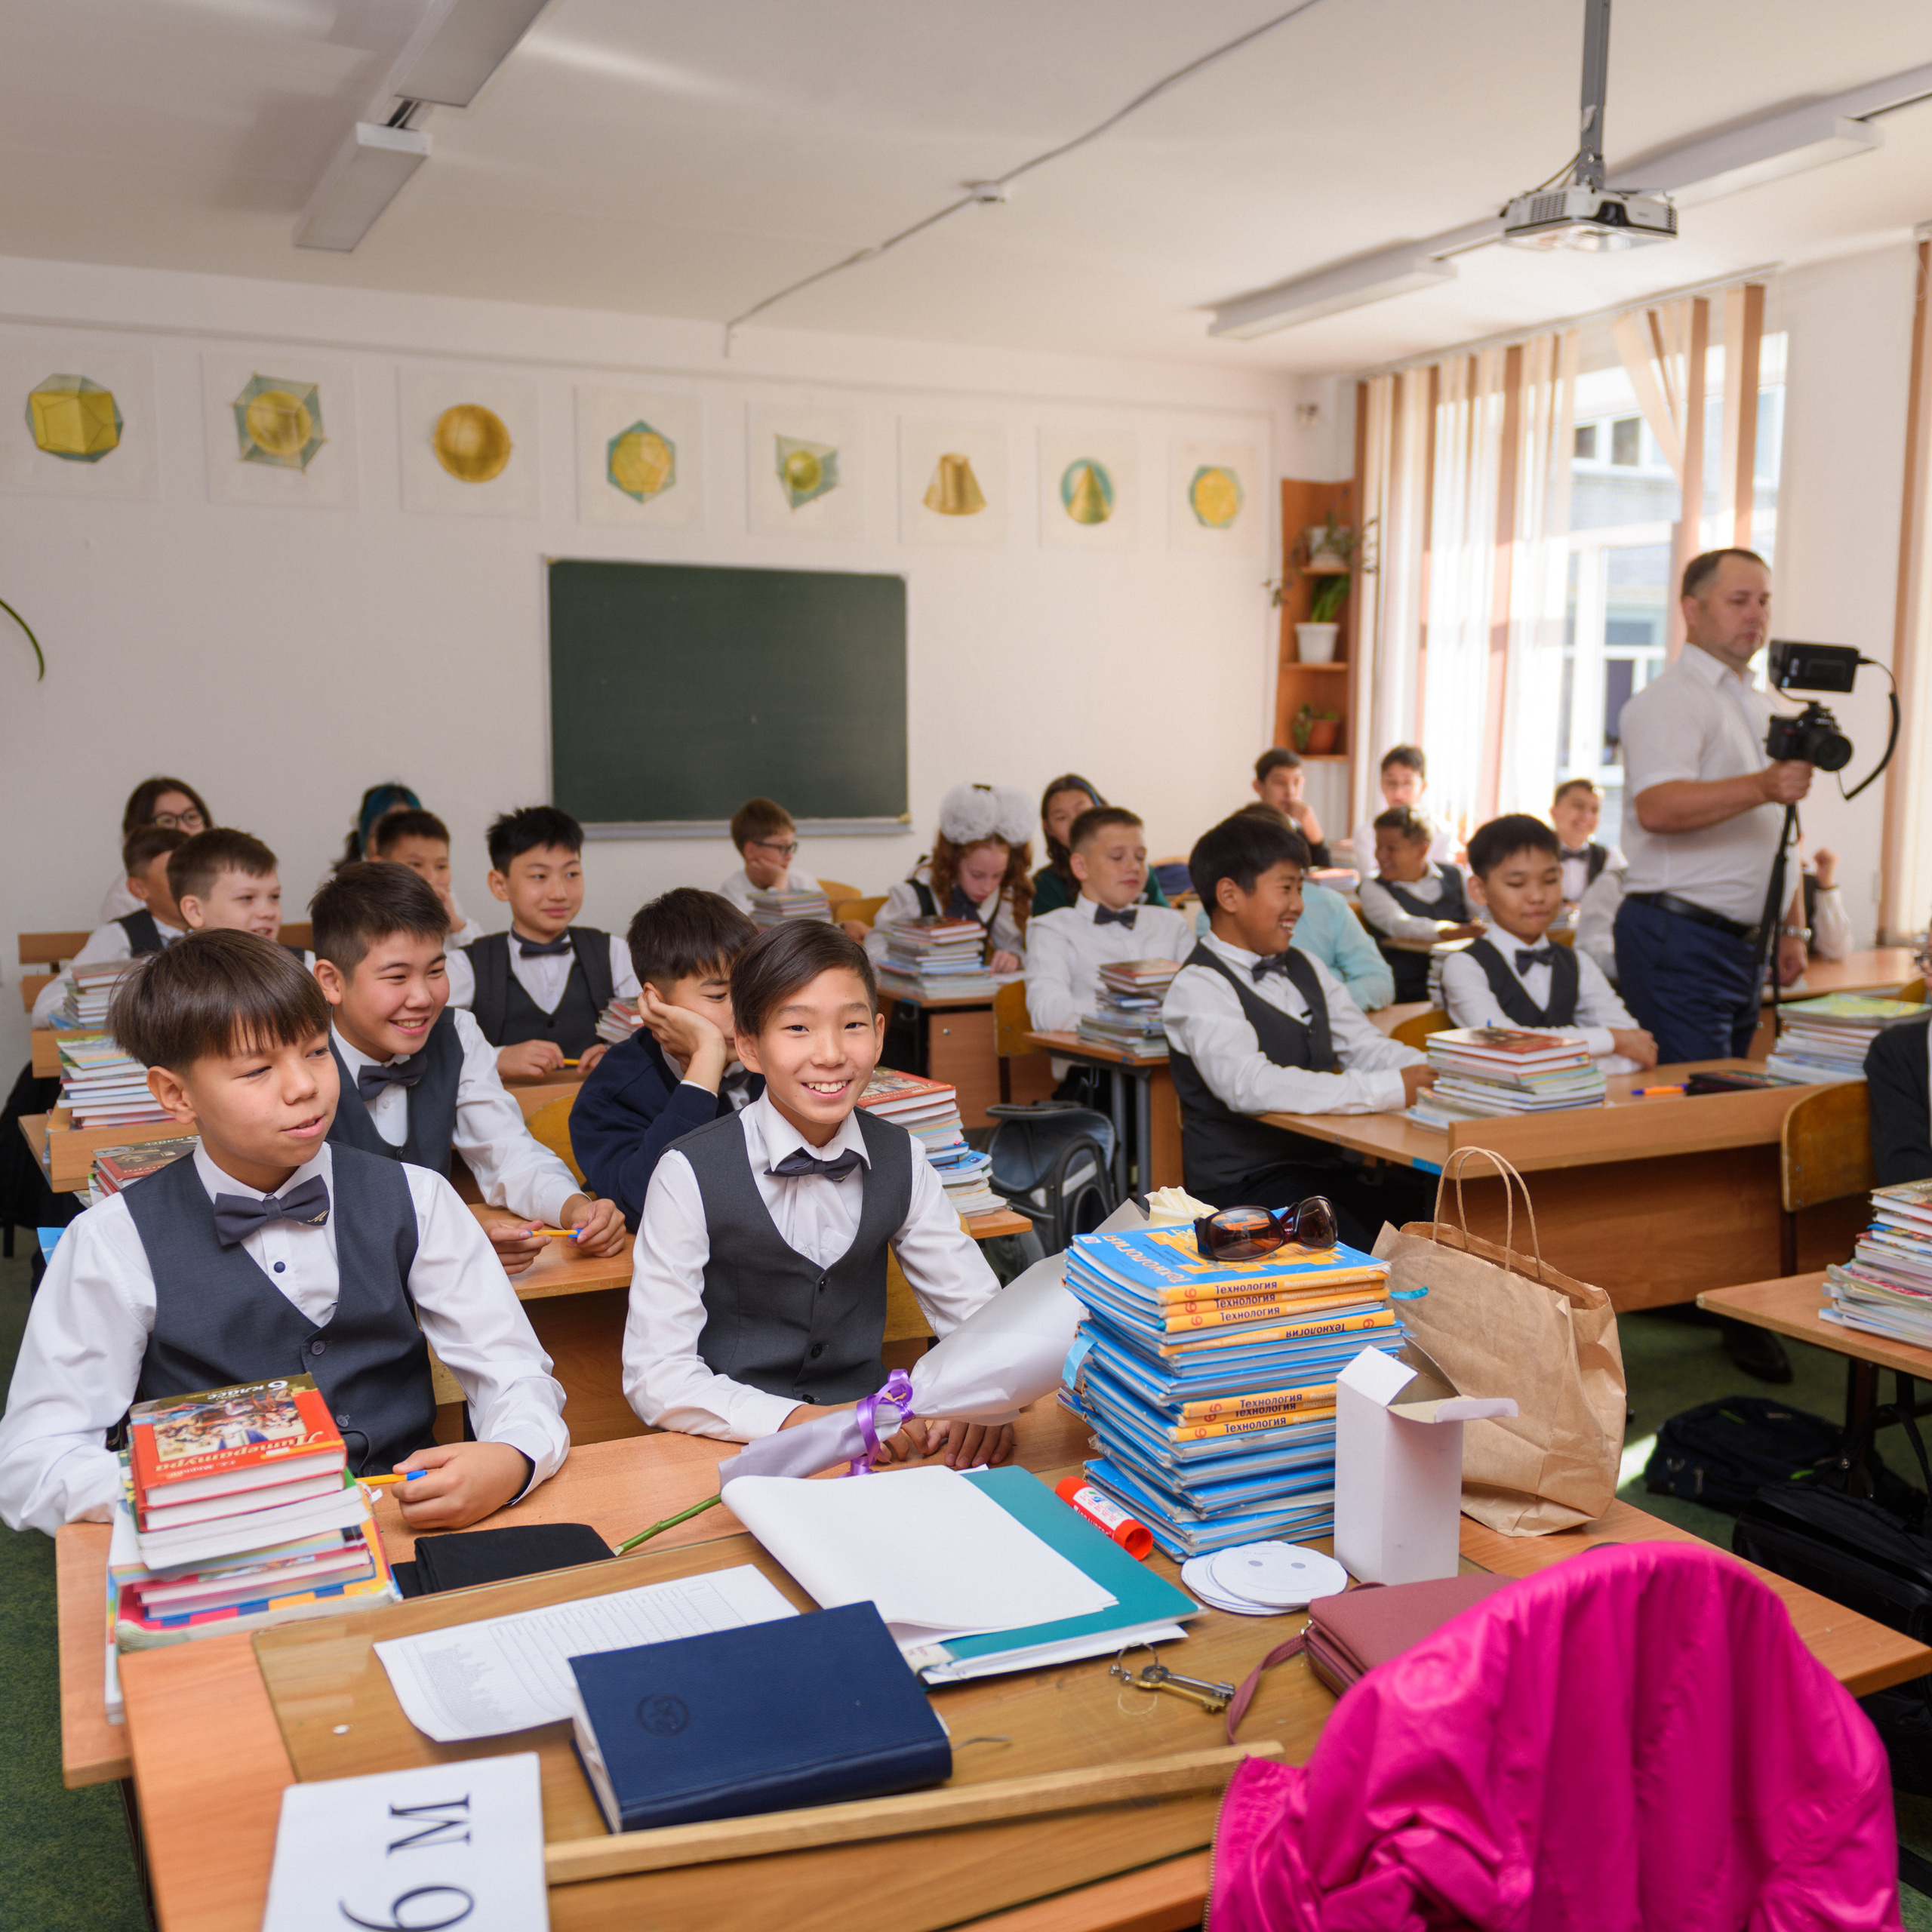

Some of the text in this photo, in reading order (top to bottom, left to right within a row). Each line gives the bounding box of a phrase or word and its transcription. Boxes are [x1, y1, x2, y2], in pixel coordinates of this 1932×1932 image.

[1102, 1234, 1192, 1284] Технология
[1184, 1287, 1197, 1298] 6
[1214, 1280, 1277, 1294] Технология
[1214, 1294, 1275, 1309] Технология
[1191, 1315, 1203, 1326] 6
[1220, 1306, 1280, 1321] Технология
[1286, 1323, 1346, 1338] Технология
[207, 1384, 265, 1401] класс
[267, 1380, 289, 1390] 6
[1209, 1403, 1223, 1413] 6
[1239, 1393, 1303, 1409] Технология
[1223, 1417, 1286, 1433] Технология
[154, 1430, 325, 1472] Литература
[338, 1884, 475, 1932] 6
